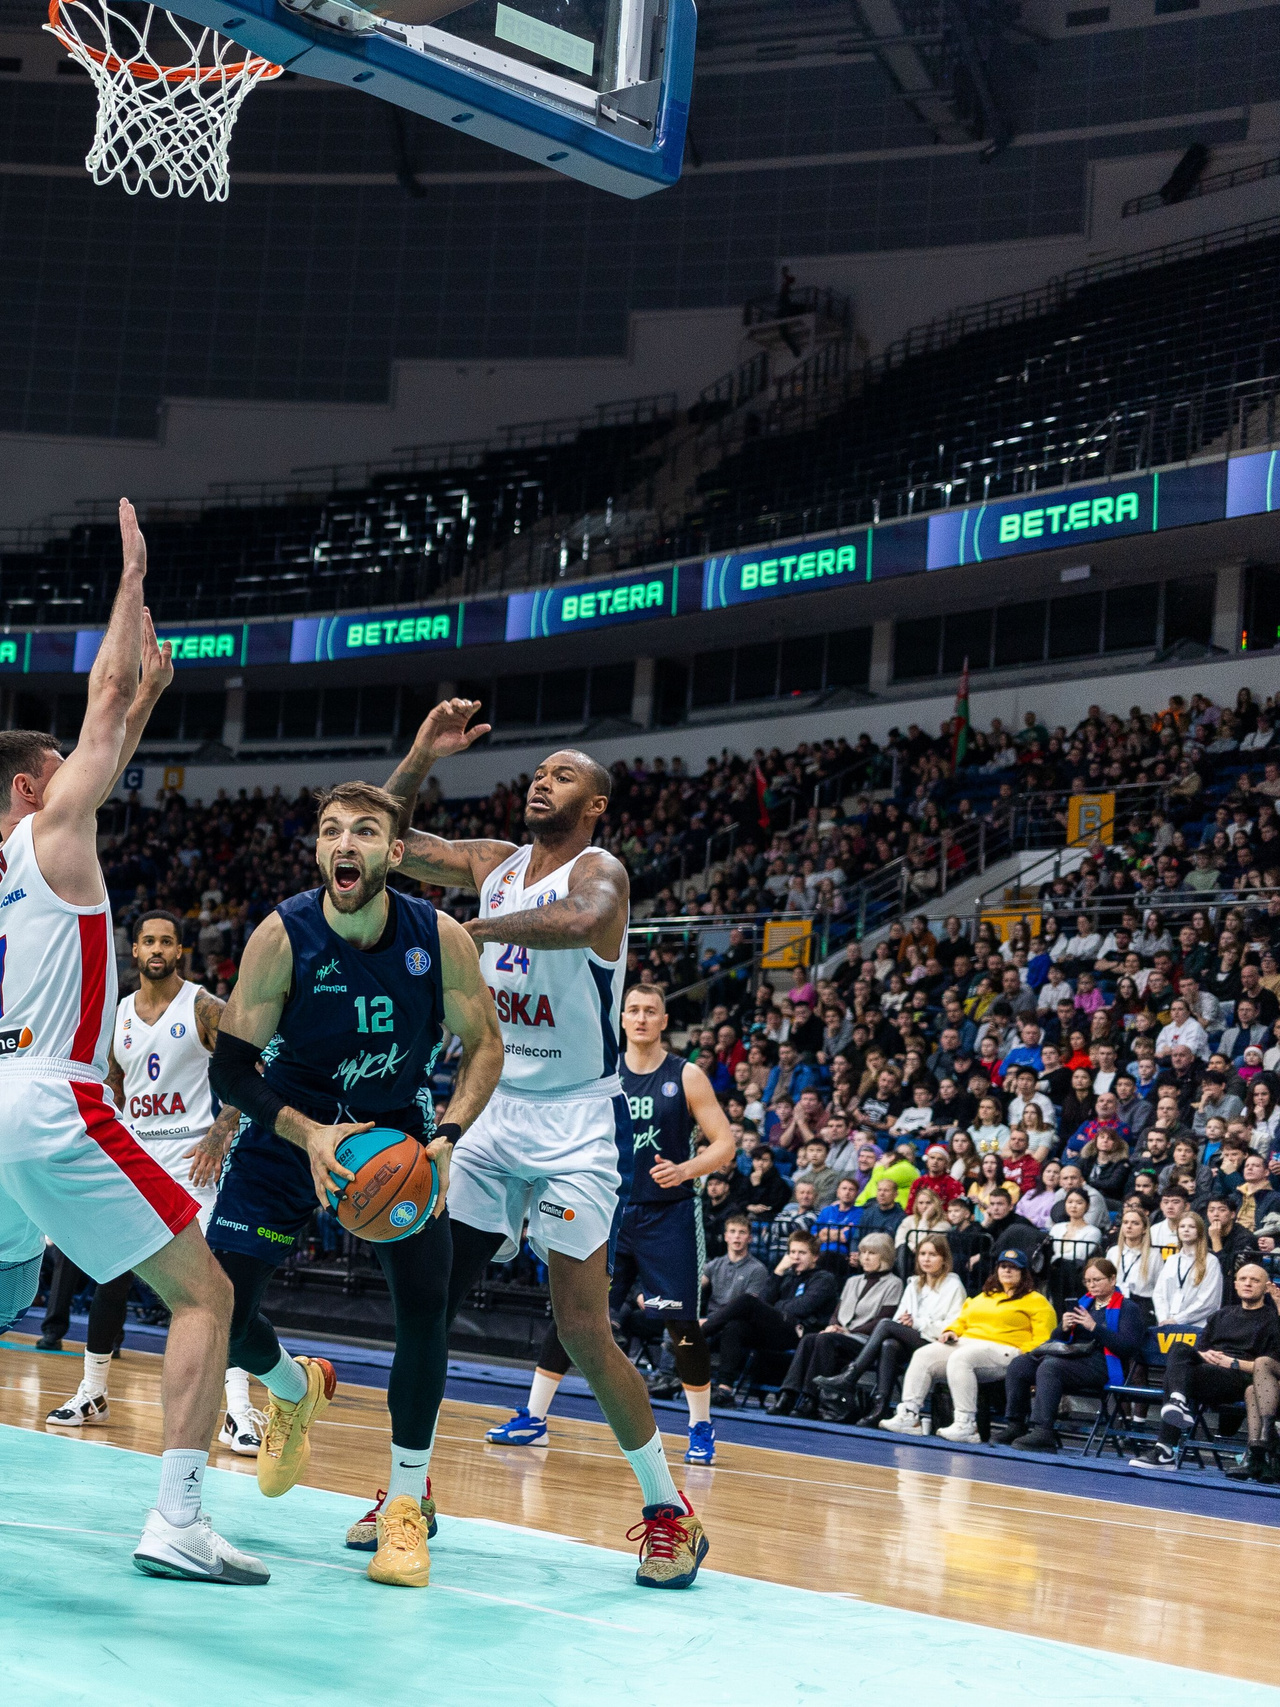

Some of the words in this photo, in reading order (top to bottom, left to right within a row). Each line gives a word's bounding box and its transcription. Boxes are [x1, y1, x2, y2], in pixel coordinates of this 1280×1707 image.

[1079, 805, 1101, 837] B
[496, 943, 530, 974] 24
[313, 983, 348, 994] Kempa
[354, 995, 394, 1033] 12
[147, 1053, 161, 1081] 6
[130, 1091, 187, 1119] CSKA
[216, 1216, 249, 1232] Kempa
